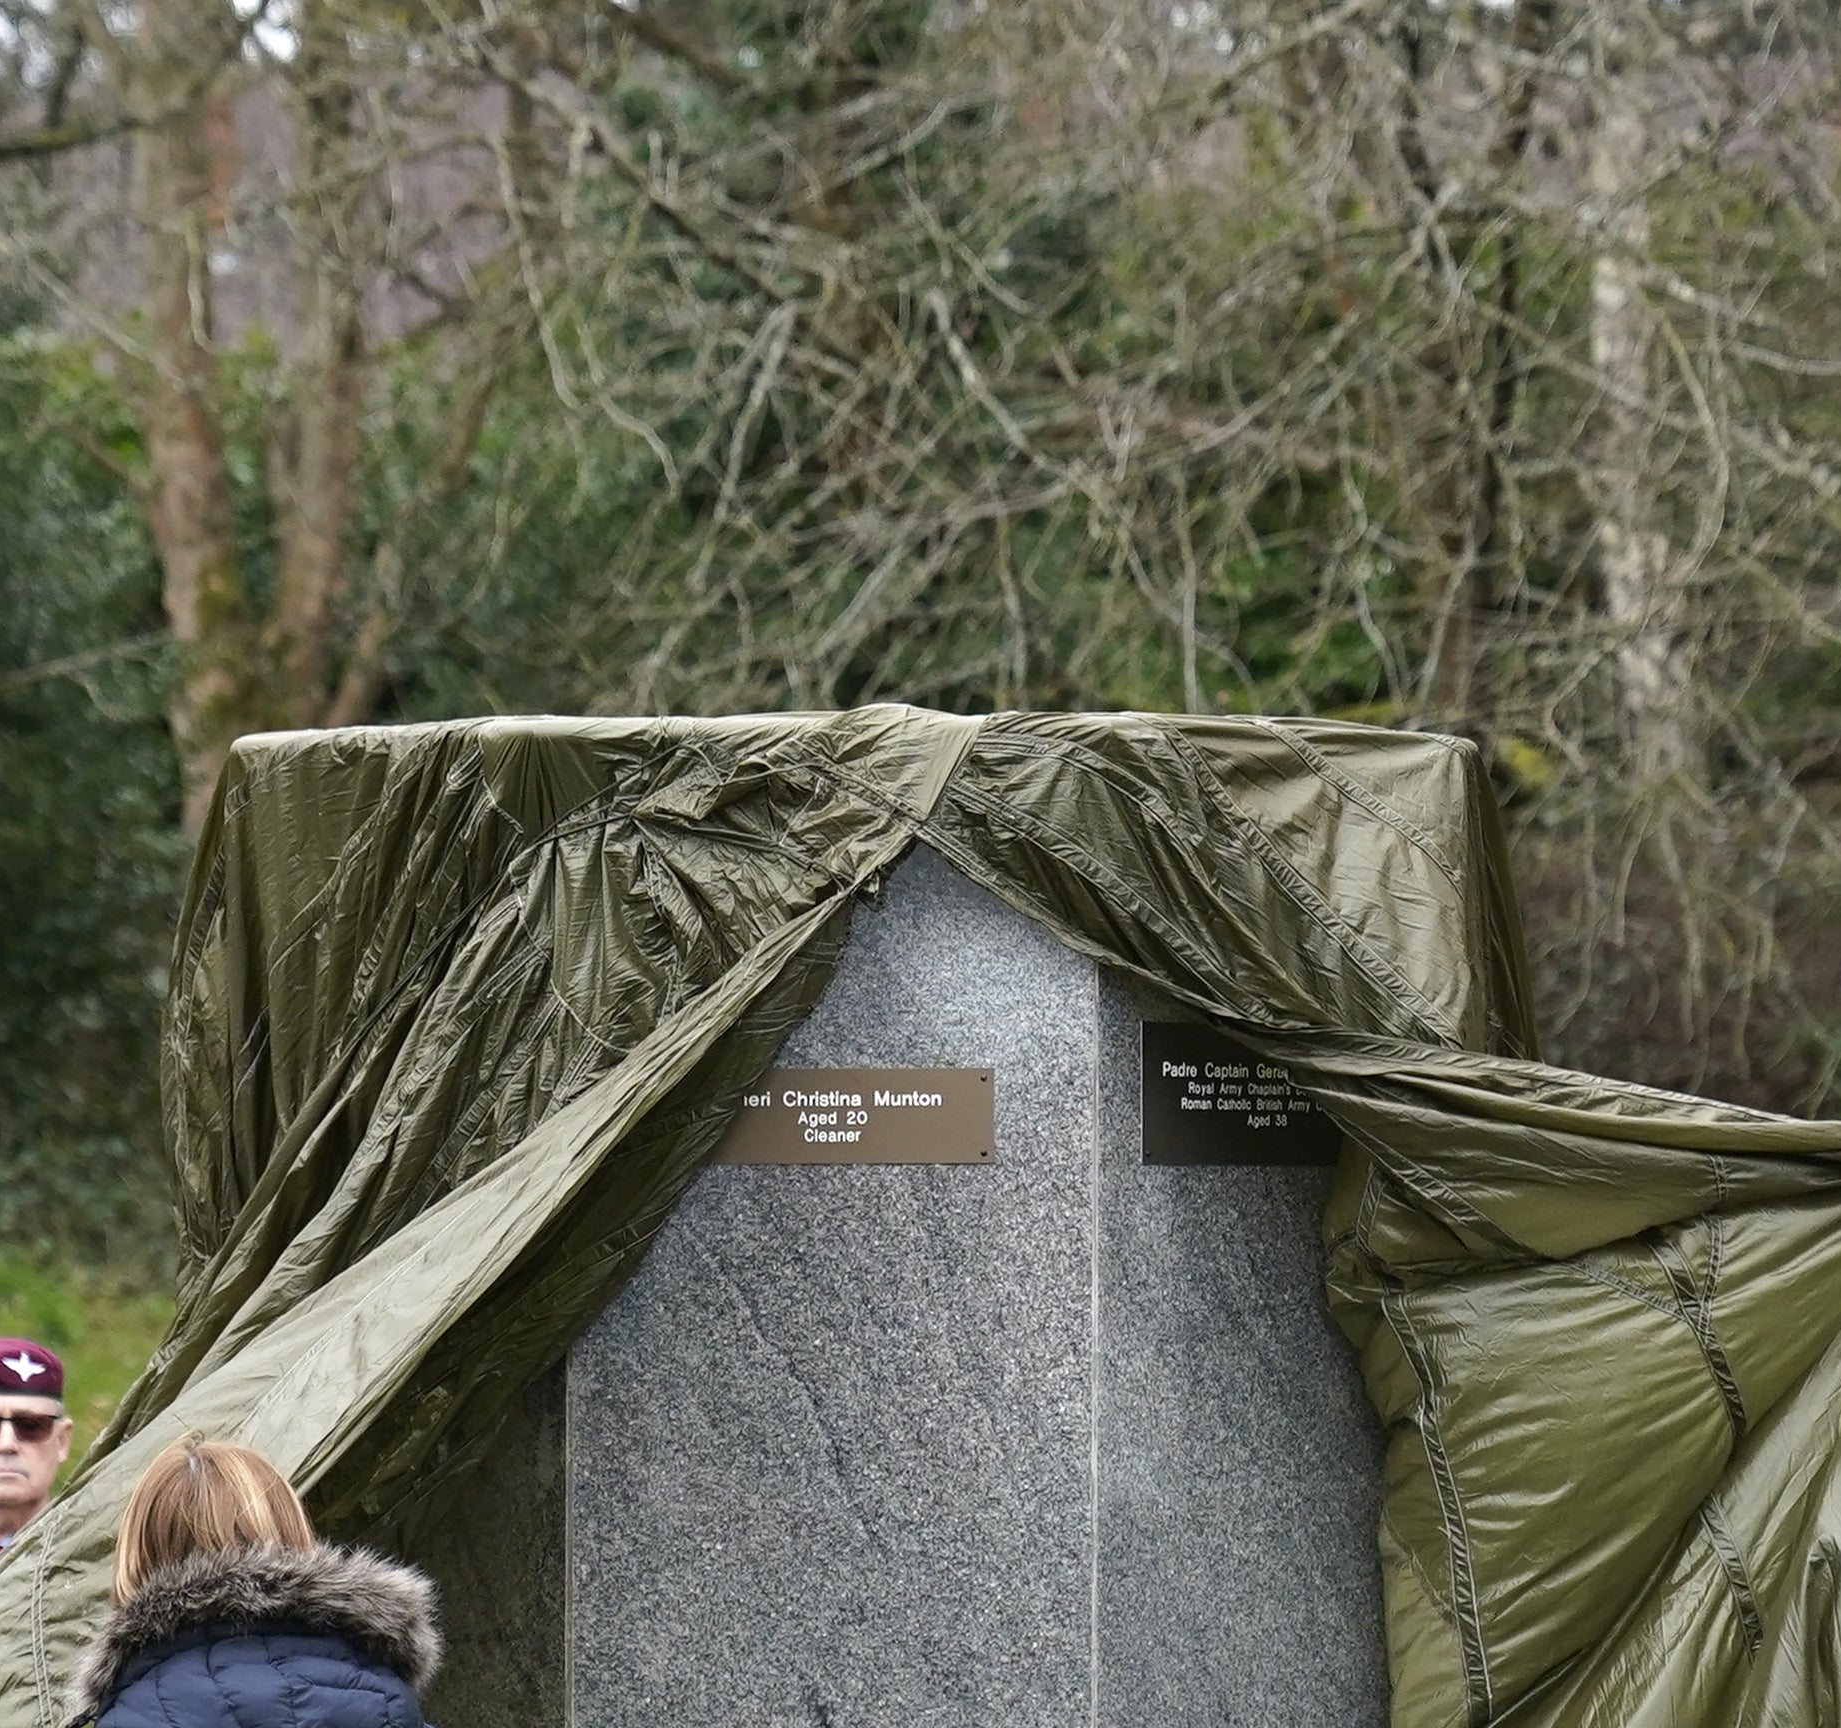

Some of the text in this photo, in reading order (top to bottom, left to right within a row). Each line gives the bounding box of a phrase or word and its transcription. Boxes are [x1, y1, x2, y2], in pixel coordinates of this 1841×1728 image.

[1162, 1061, 1198, 1078] Padre
[1205, 1062, 1249, 1080] Captain
[1188, 1082, 1215, 1096] Royal
[1219, 1082, 1243, 1096] Army
[1247, 1082, 1291, 1096] Chaplain's
[782, 1090, 862, 1107] Christina
[873, 1090, 943, 1107] Munton
[1180, 1098, 1212, 1111] Roman
[1217, 1098, 1252, 1111] Catholic
[1287, 1099, 1311, 1113] Army
[797, 1111, 868, 1128] Aged 20
[1247, 1115, 1288, 1129] Aged 38
[804, 1128, 862, 1143] Cleaner
